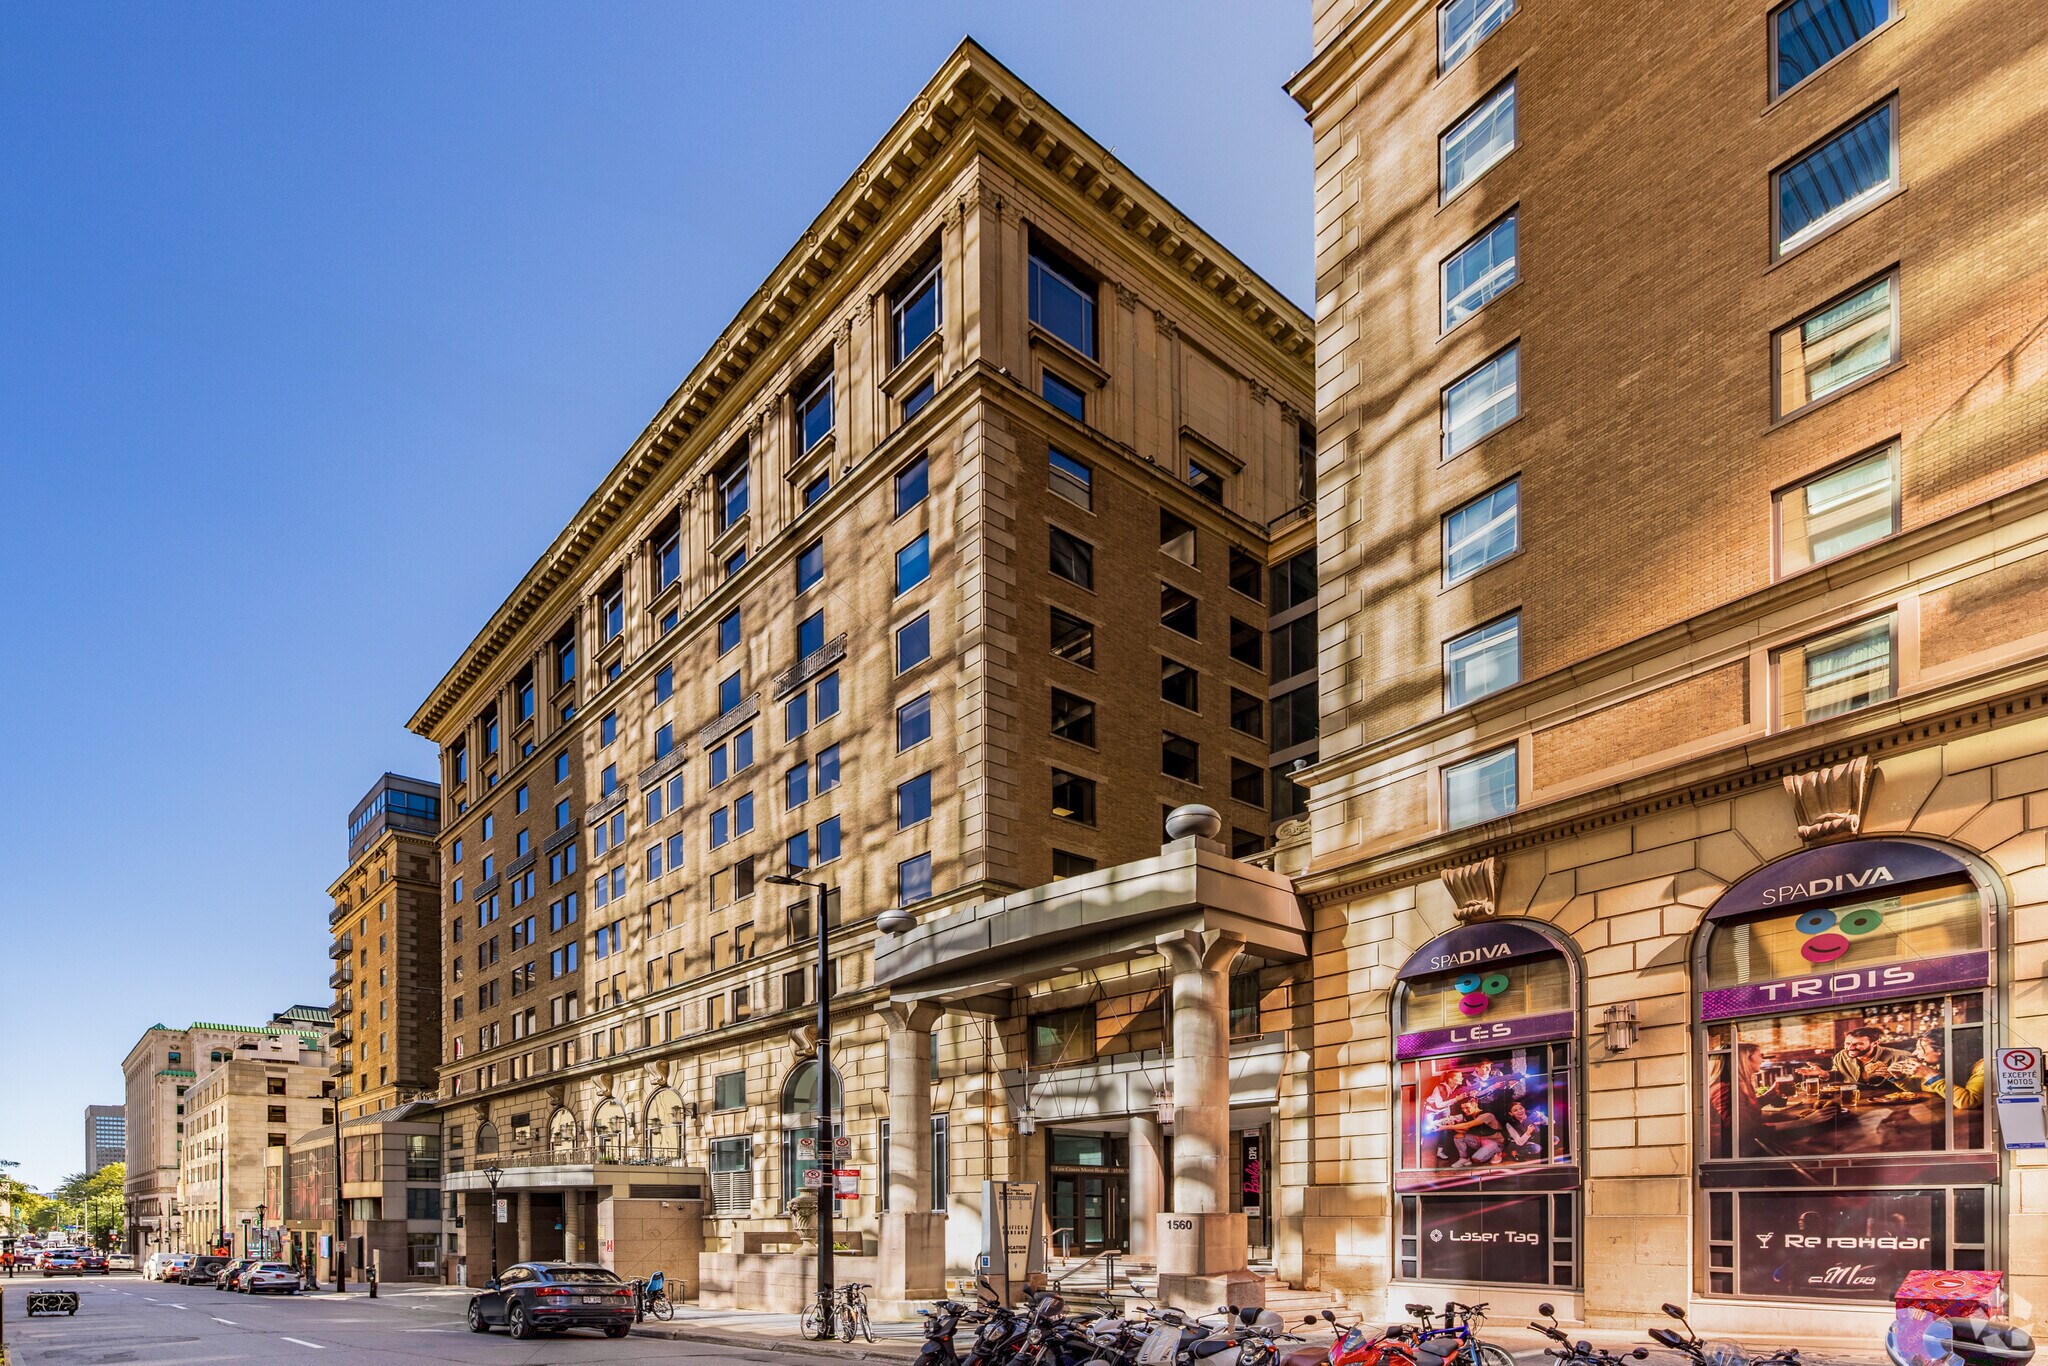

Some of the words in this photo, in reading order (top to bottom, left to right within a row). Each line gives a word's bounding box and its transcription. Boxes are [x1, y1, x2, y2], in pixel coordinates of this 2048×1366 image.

[1763, 866, 1894, 905] SPADIVA
[1430, 943, 1512, 970] SPADIVA
[1759, 966, 1915, 1001] TROIS
[1450, 1023, 1512, 1043] LES
[2002, 1070, 2037, 1079] EXCEPTÉ
[2007, 1078, 2034, 1086] MOTOS
[1167, 1220, 1193, 1230] 1560
[1449, 1230, 1500, 1242] Laser
[1504, 1231, 1539, 1245] Tag
